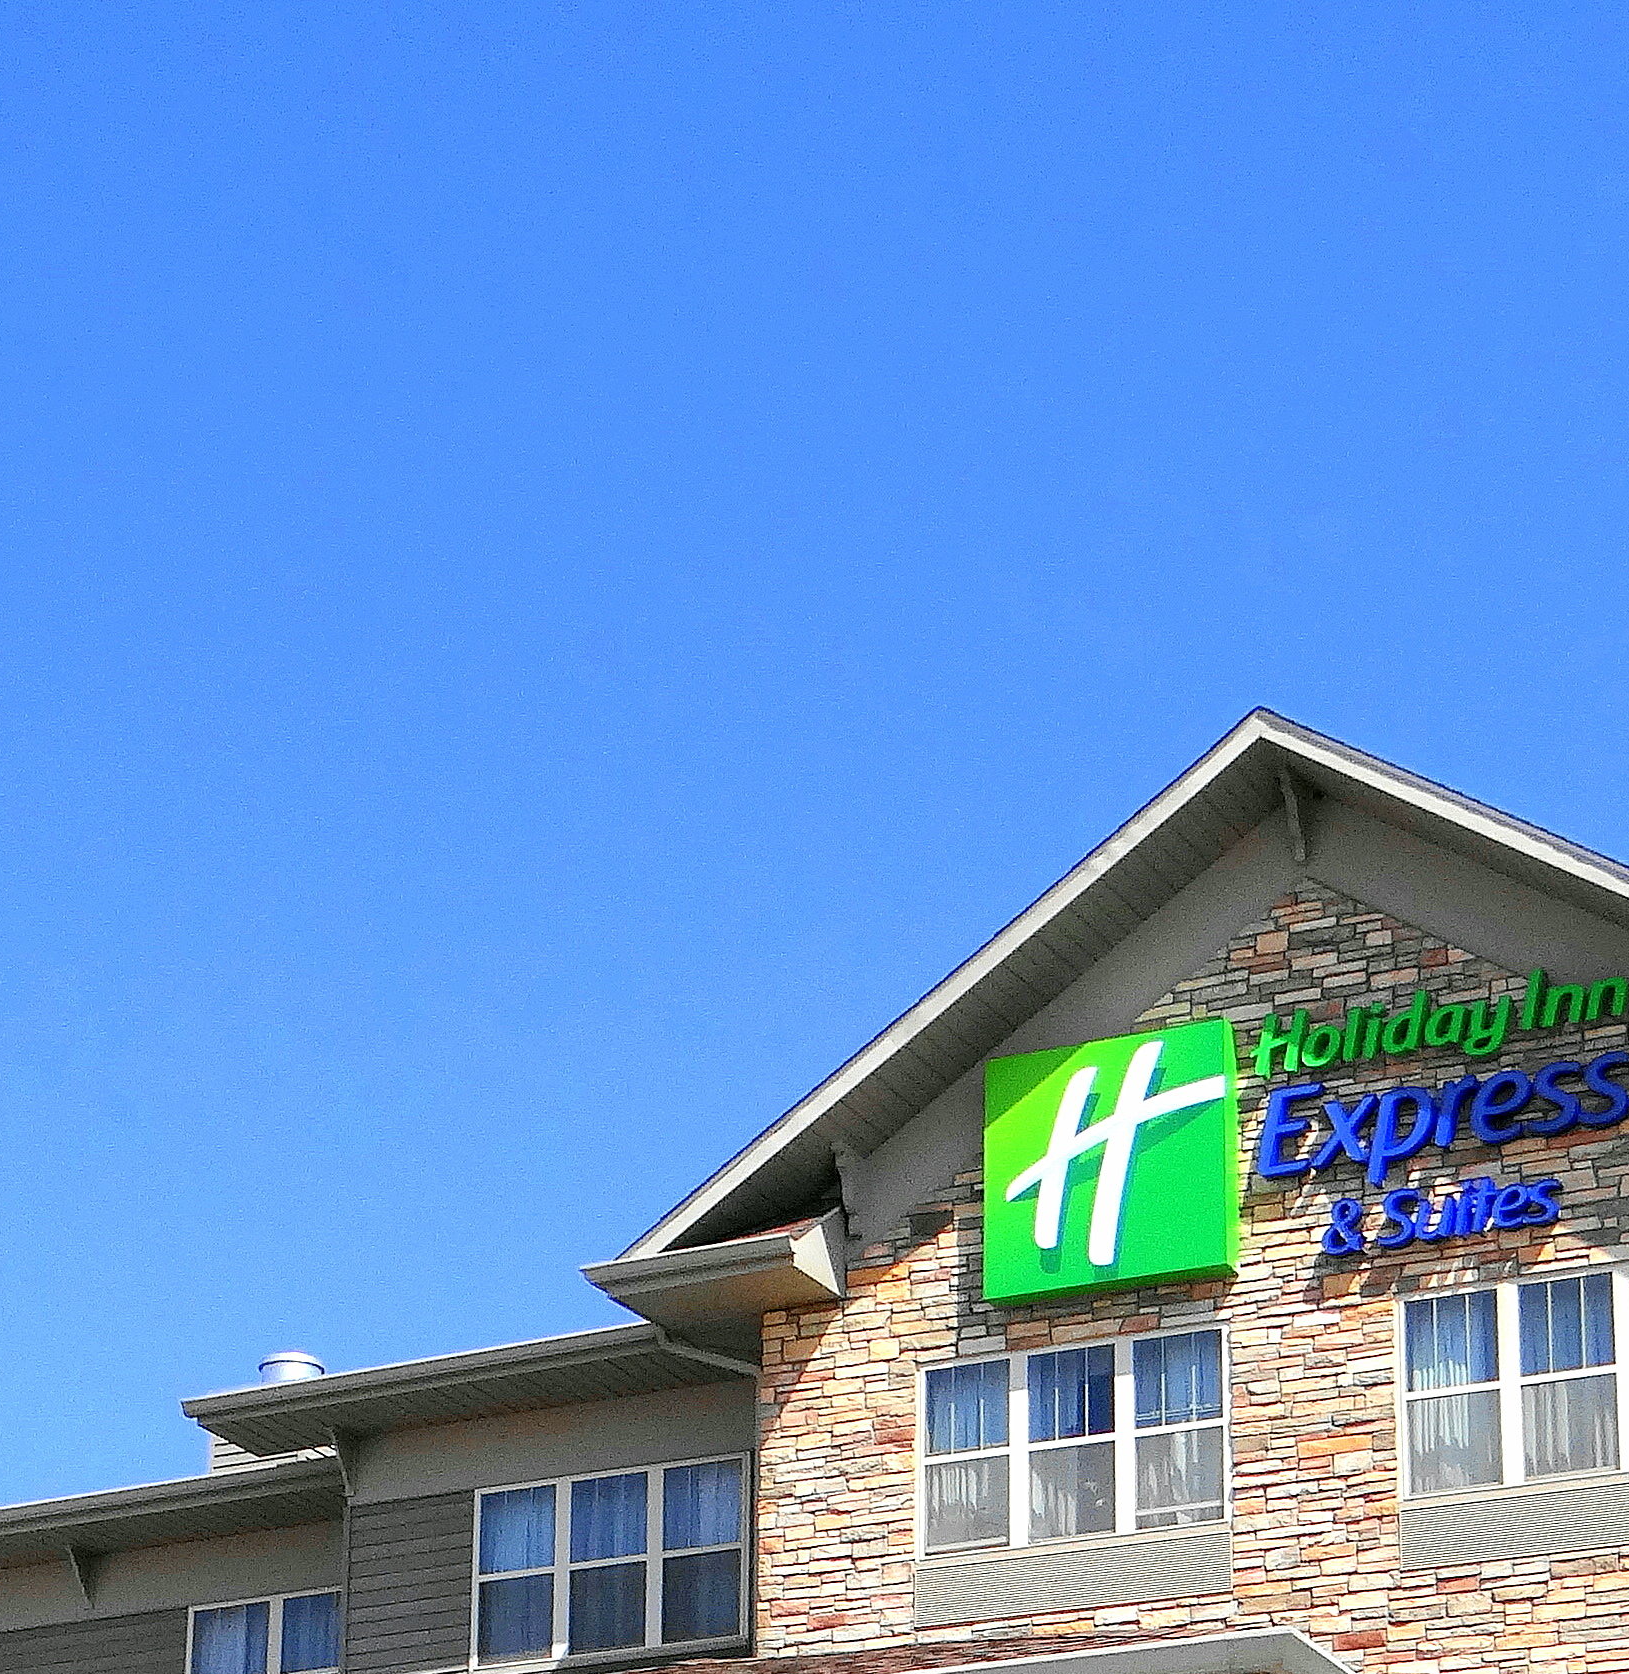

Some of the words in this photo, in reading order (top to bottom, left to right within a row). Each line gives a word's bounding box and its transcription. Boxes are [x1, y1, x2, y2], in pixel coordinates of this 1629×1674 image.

[1251, 988, 1512, 1078] Holiday
[1322, 1197, 1367, 1256] &
[1376, 1175, 1564, 1249] Suites
